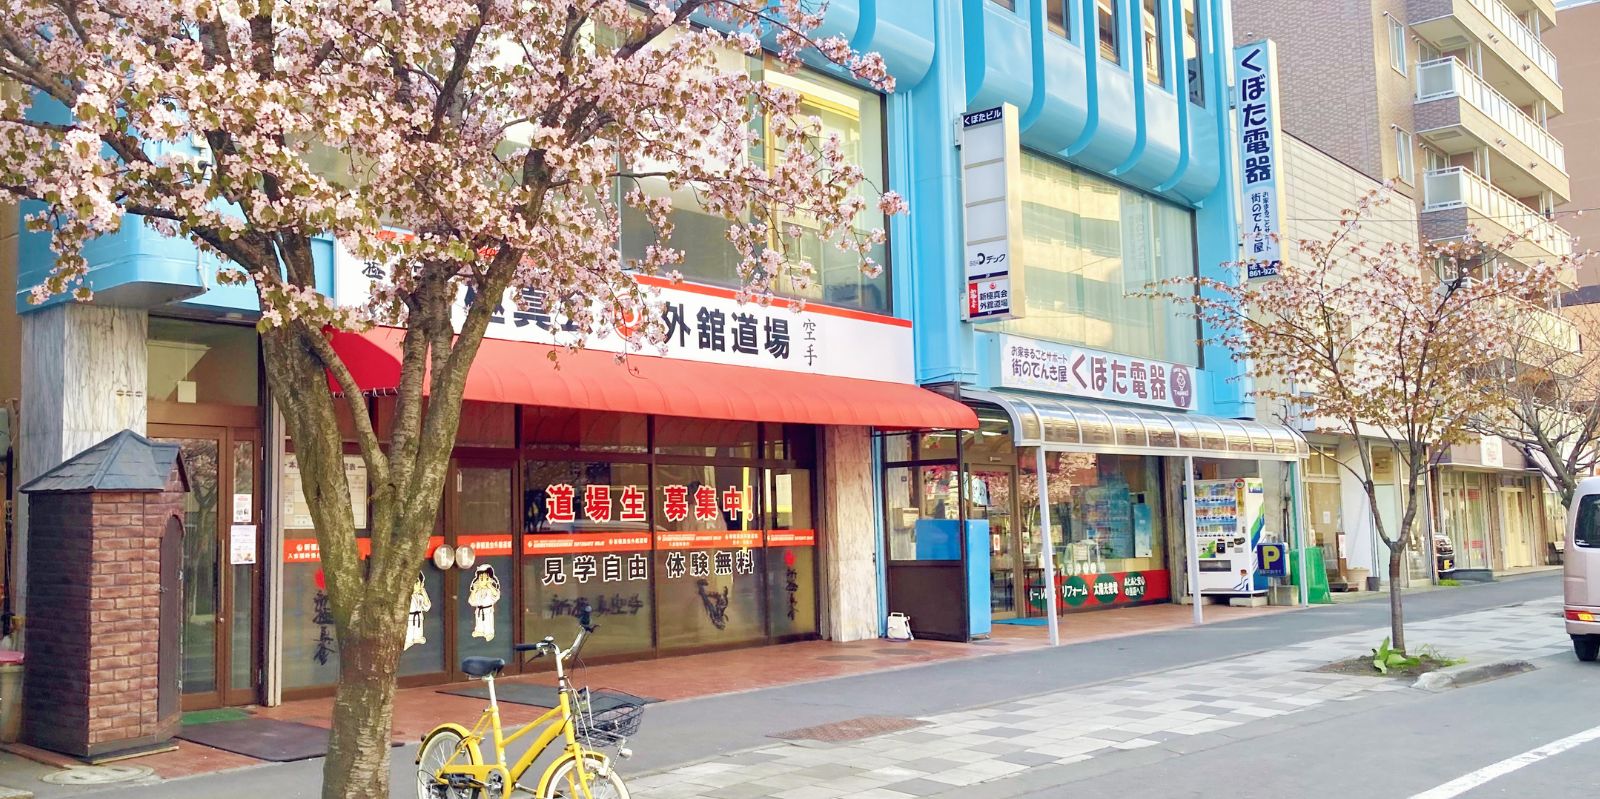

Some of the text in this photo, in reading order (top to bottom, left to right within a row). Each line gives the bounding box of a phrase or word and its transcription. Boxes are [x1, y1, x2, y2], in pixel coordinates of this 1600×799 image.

[964, 109, 1002, 125] くぼたビル
[1241, 48, 1271, 184] くぼた電器
[802, 318, 818, 367] 空手
[1011, 346, 1068, 364] お家まるごとサポート
[1011, 358, 1068, 382] 街のでんき屋
[1071, 353, 1167, 401] くぼた電器
[545, 483, 754, 524] 道場生 募集中!
[542, 550, 755, 586] 見学自由 体験無料
[1263, 545, 1280, 570] P
[1062, 585, 1088, 598] リフォーム
[1093, 581, 1119, 596] 太陽光発電
